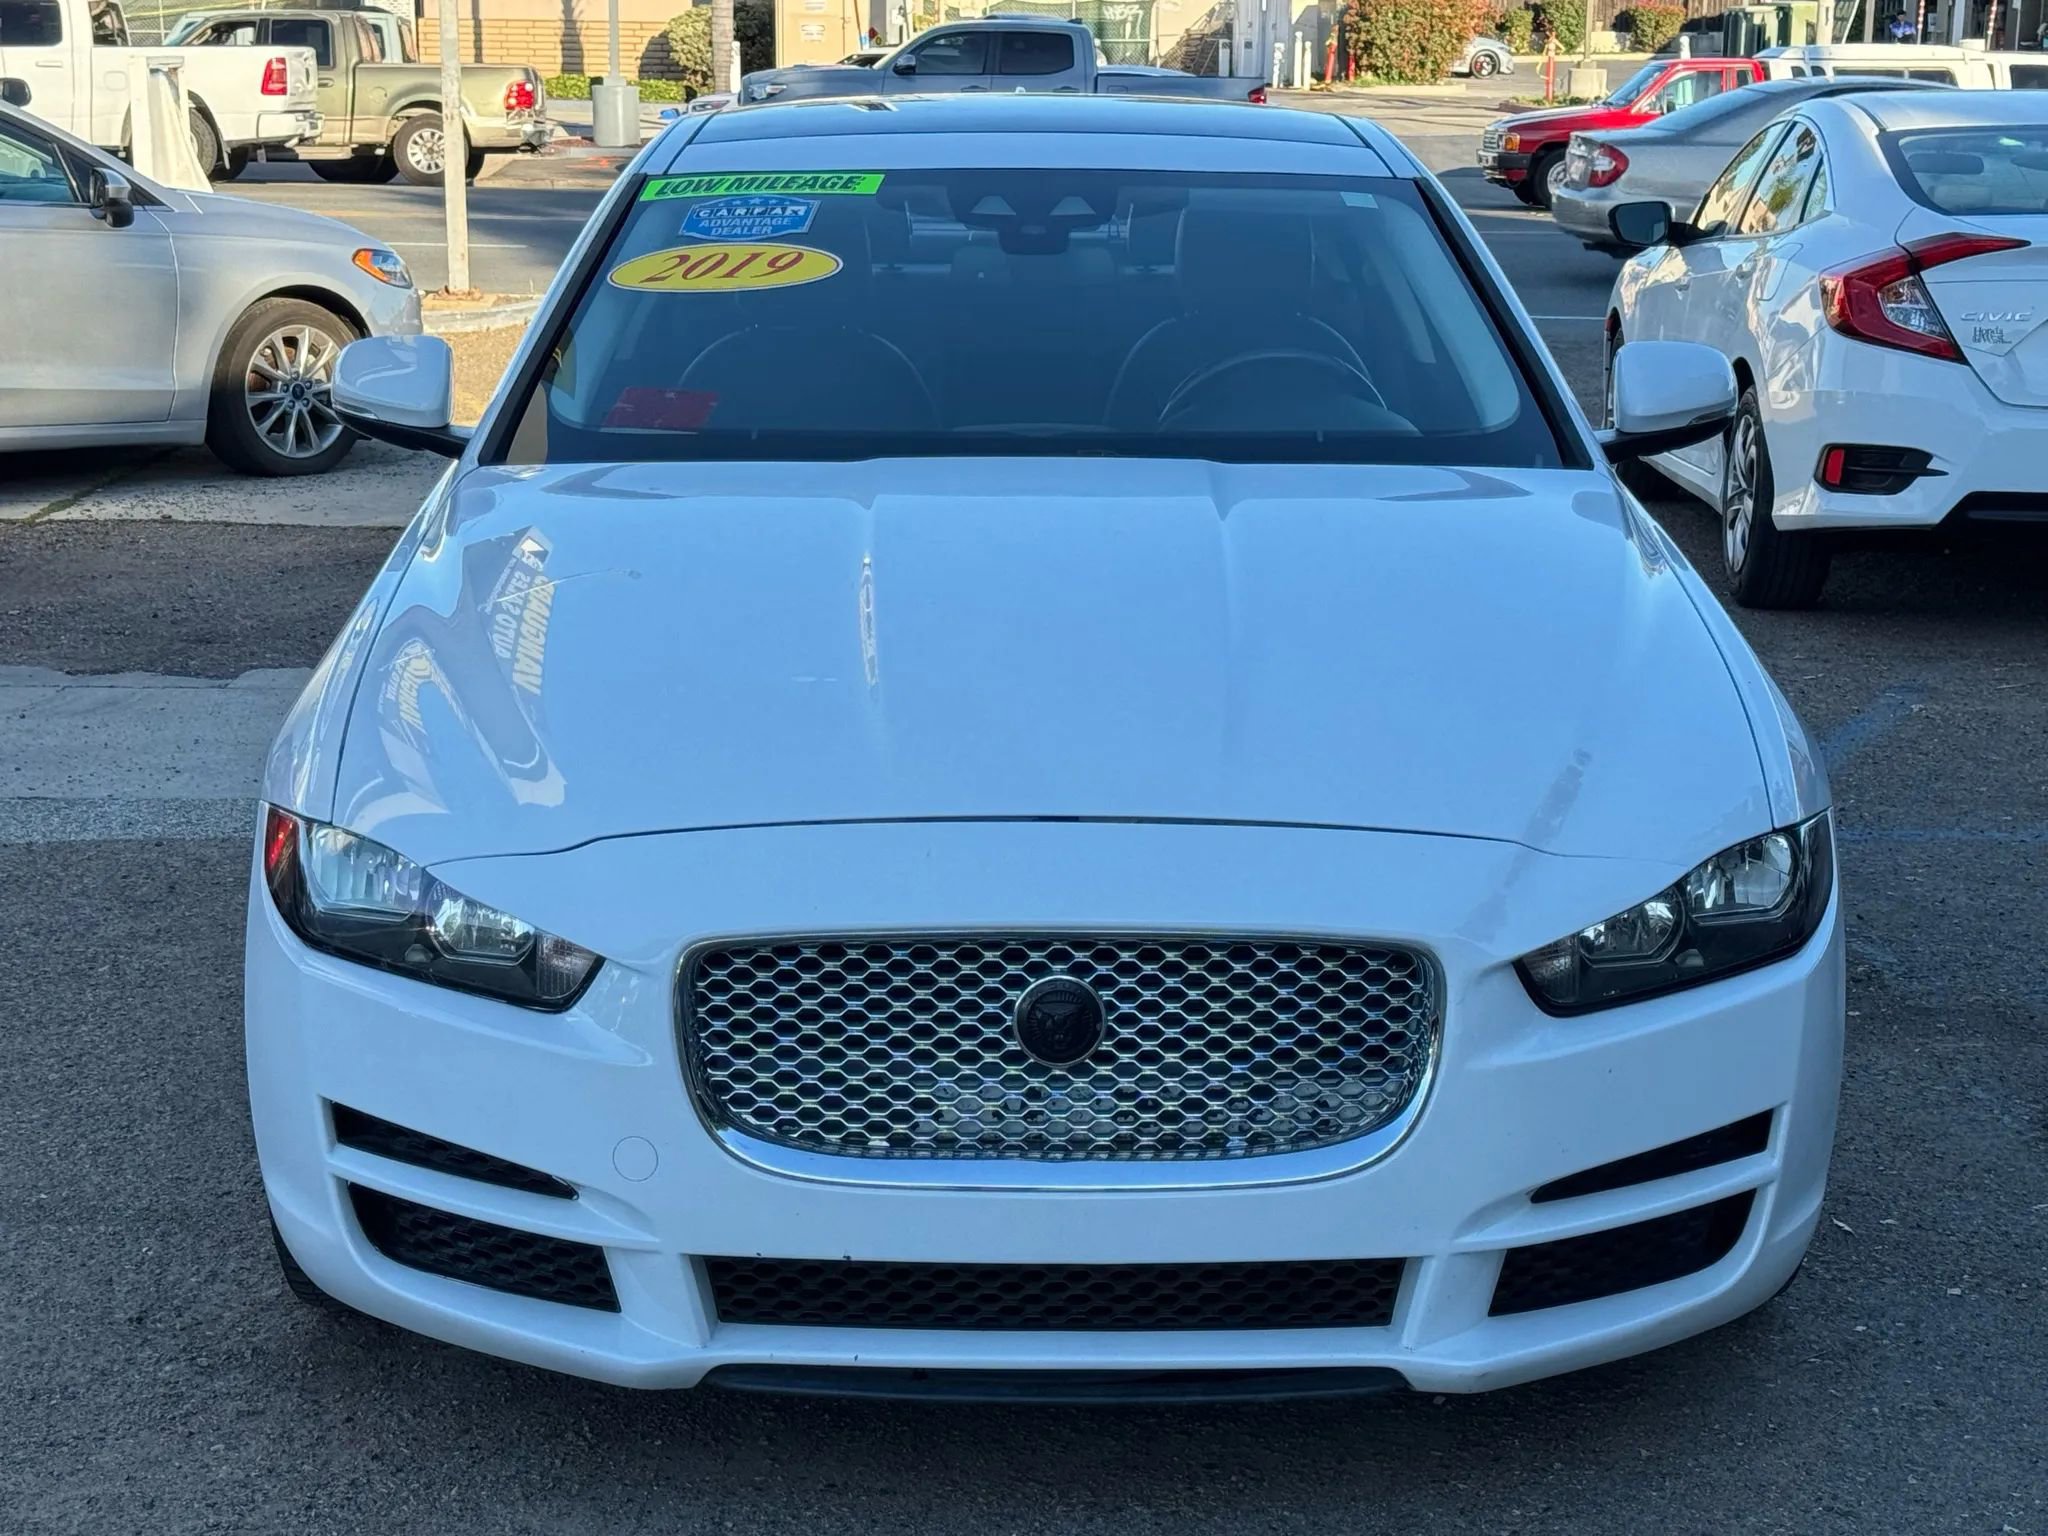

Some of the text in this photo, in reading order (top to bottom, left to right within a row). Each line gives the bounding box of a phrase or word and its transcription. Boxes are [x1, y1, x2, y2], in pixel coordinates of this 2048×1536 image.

[655, 174, 863, 197] LOW MILEAGE
[697, 205, 807, 218] CARFAX
[699, 217, 792, 228] ADVANTAGE
[711, 226, 773, 236] DEALER
[640, 250, 805, 284] 2019
[1960, 312, 2032, 322] CIVIC
